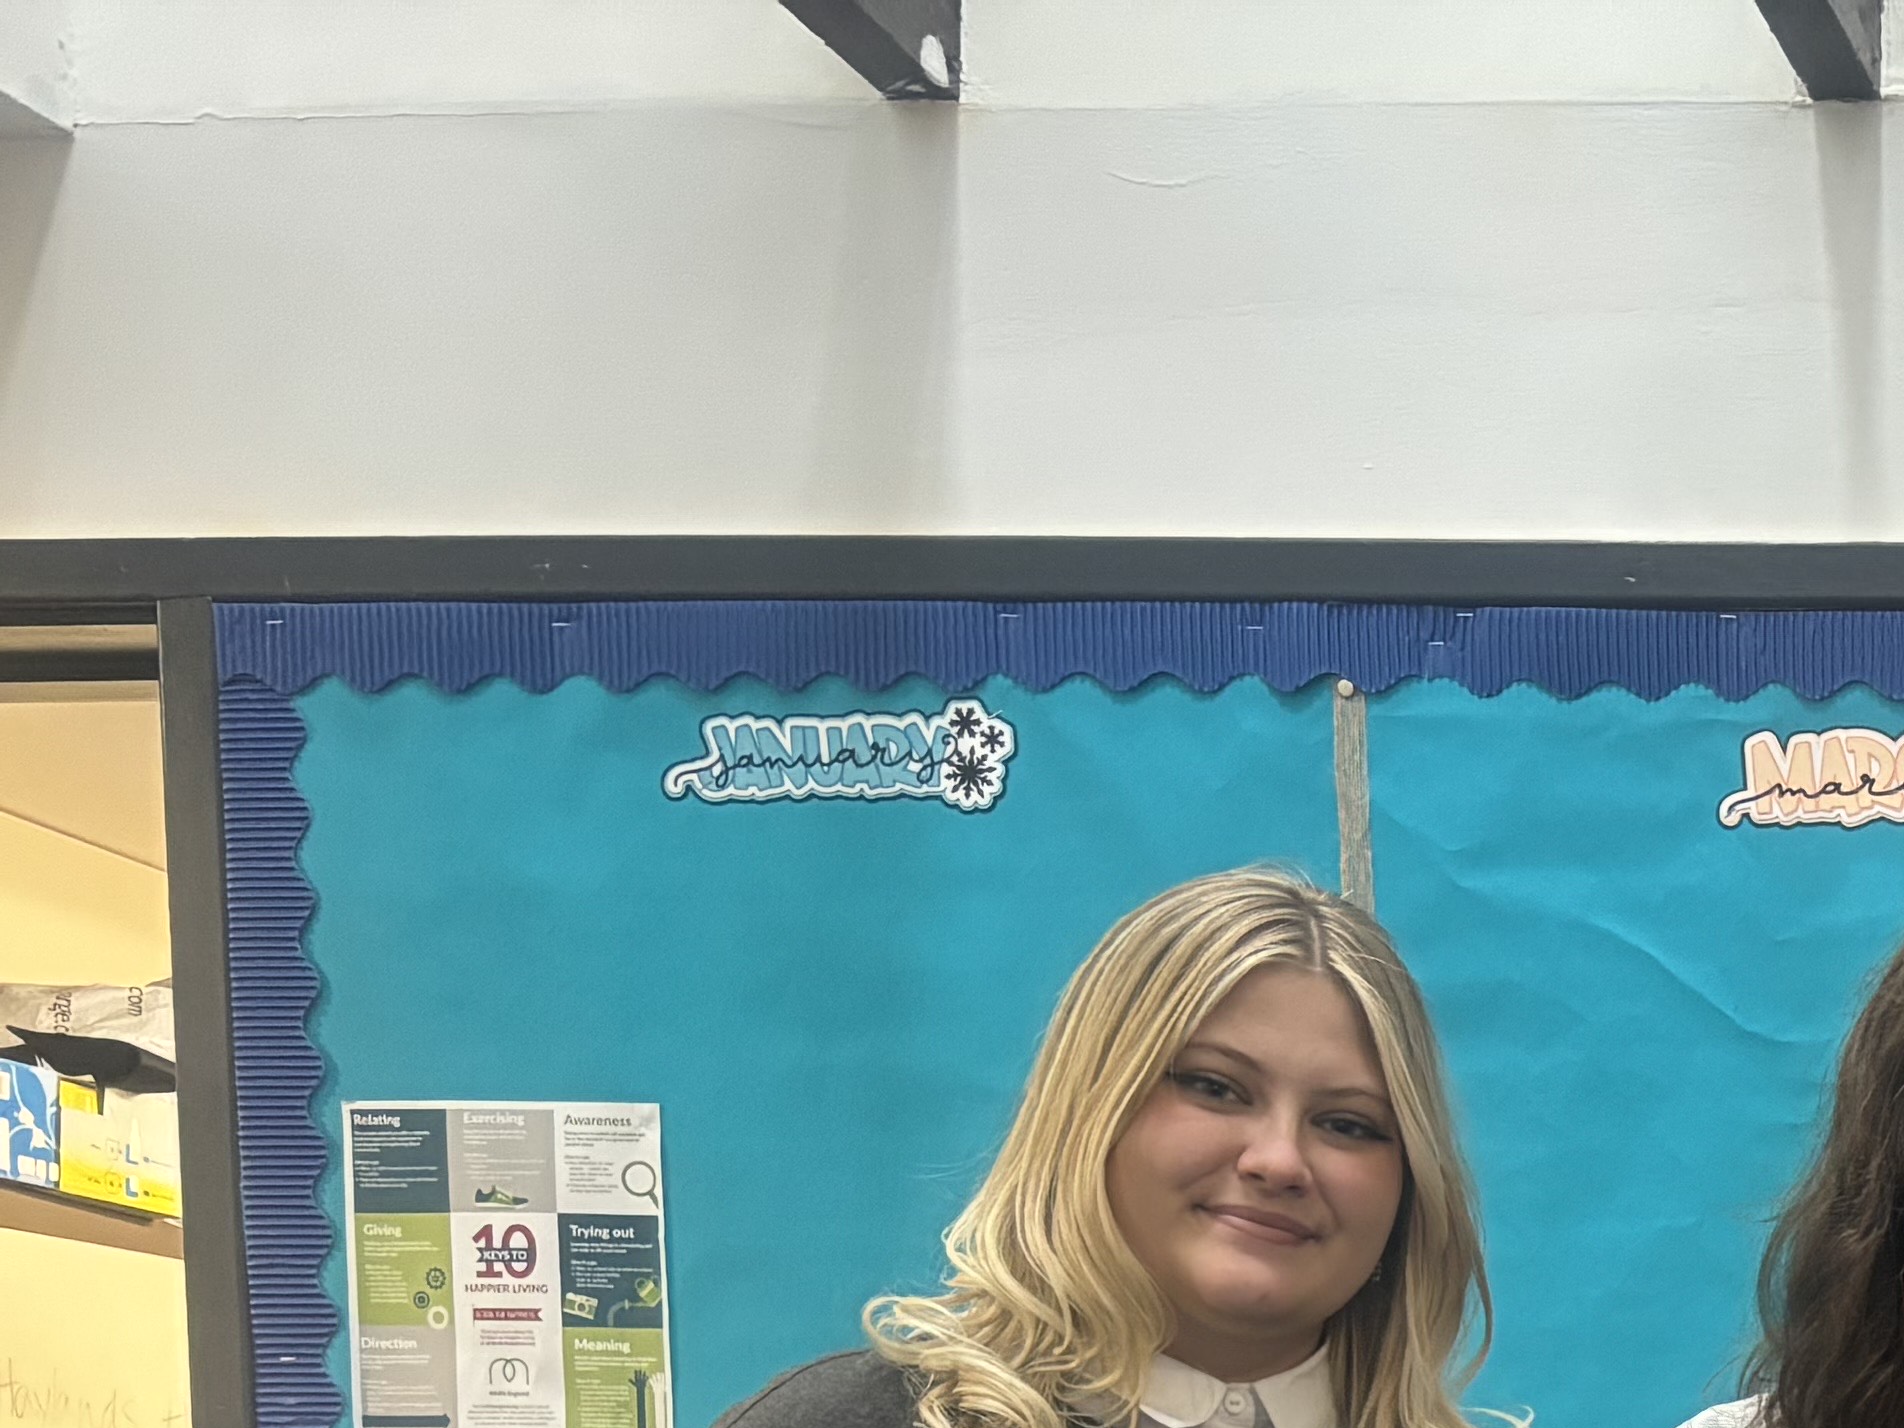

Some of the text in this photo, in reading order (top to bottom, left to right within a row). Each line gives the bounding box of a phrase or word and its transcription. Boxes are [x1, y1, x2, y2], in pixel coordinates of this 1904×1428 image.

[353, 1114, 401, 1128] Relating
[564, 1114, 632, 1127] Awareness
[363, 1224, 402, 1238] Giving
[569, 1224, 635, 1240] Trying out
[472, 1223, 537, 1279] 10
[482, 1251, 527, 1260] KEYS TO
[465, 1284, 548, 1294] HAPPIER LIVING
[361, 1337, 417, 1349] Direction
[574, 1338, 631, 1354] Meaning
